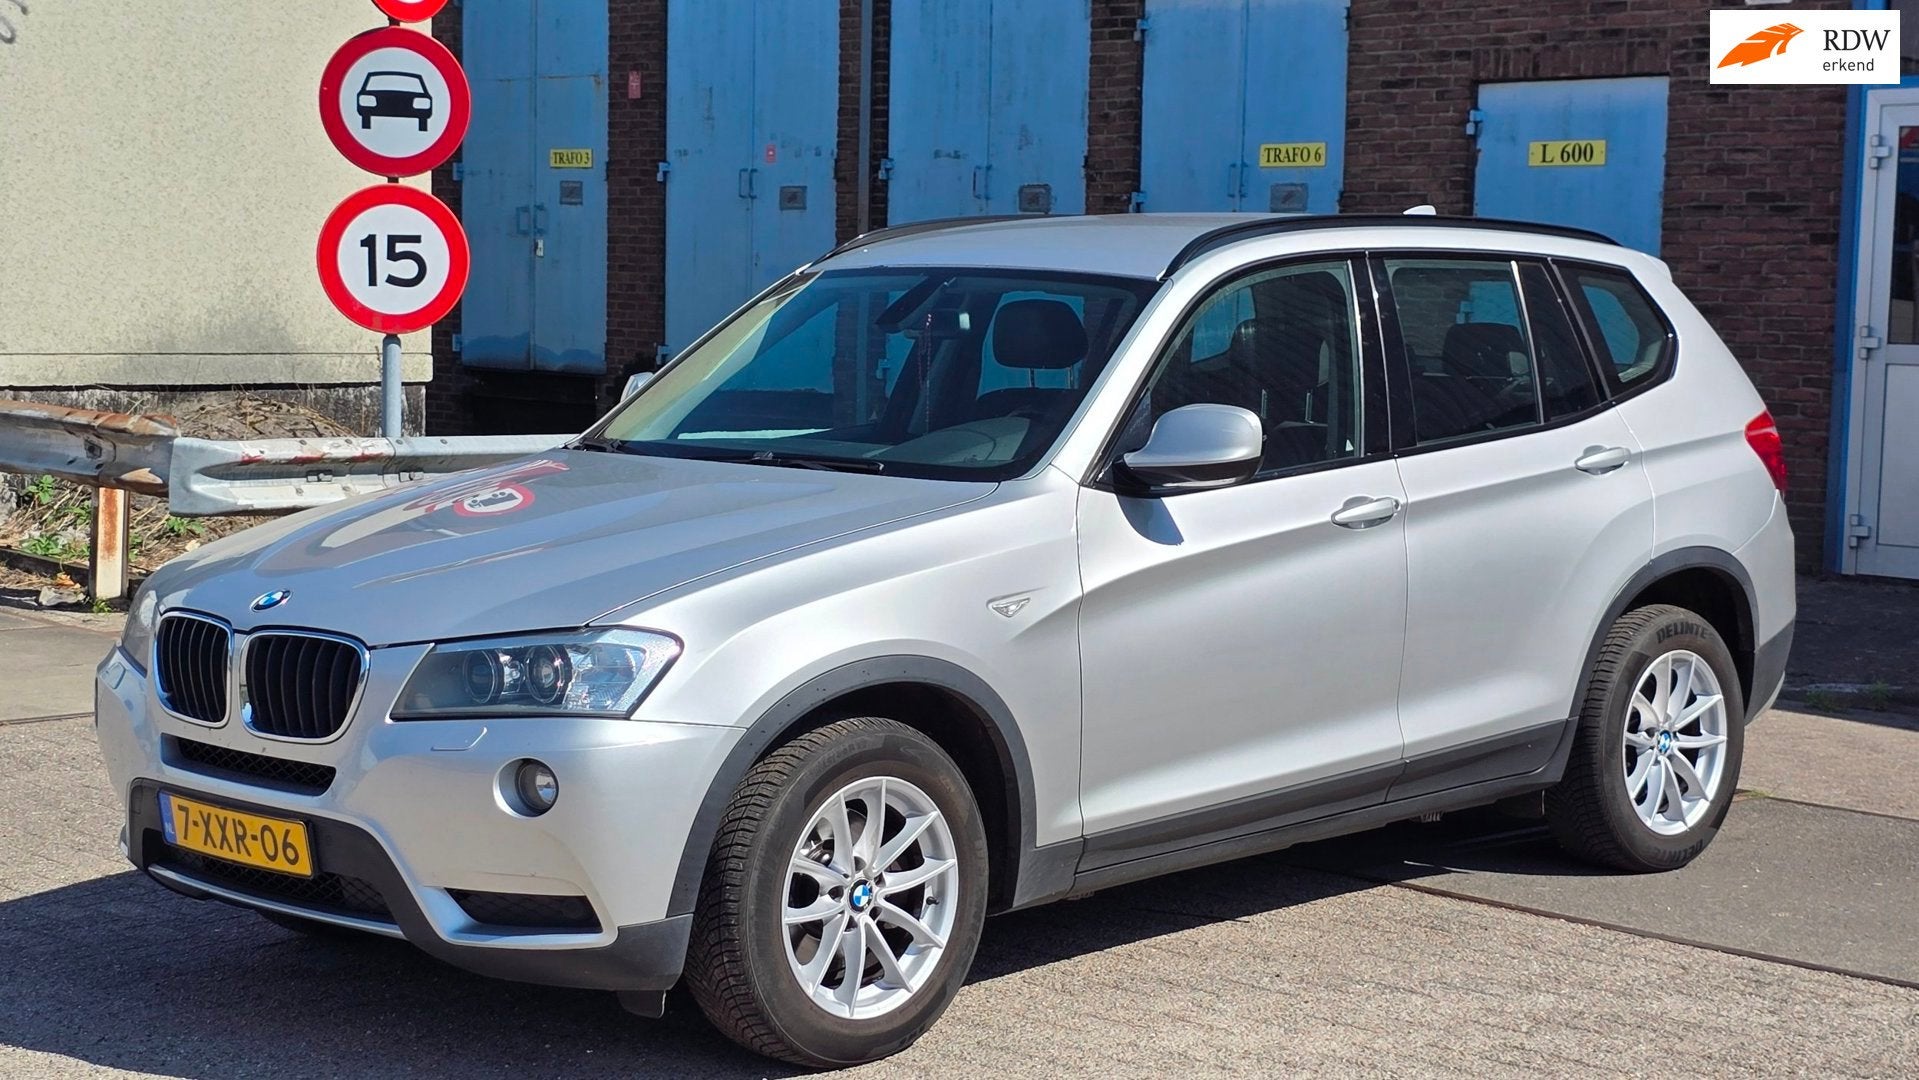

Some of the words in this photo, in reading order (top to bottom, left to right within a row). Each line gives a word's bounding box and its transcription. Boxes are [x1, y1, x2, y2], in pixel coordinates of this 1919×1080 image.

[553, 151, 583, 165] TRAFO
[584, 151, 590, 165] 3
[1264, 147, 1311, 163] TRAFO
[1314, 146, 1322, 163] 6
[1540, 143, 1555, 163] L
[1560, 142, 1594, 163] 600
[360, 233, 427, 288] 15
[177, 804, 300, 866] 7-XXR-06
